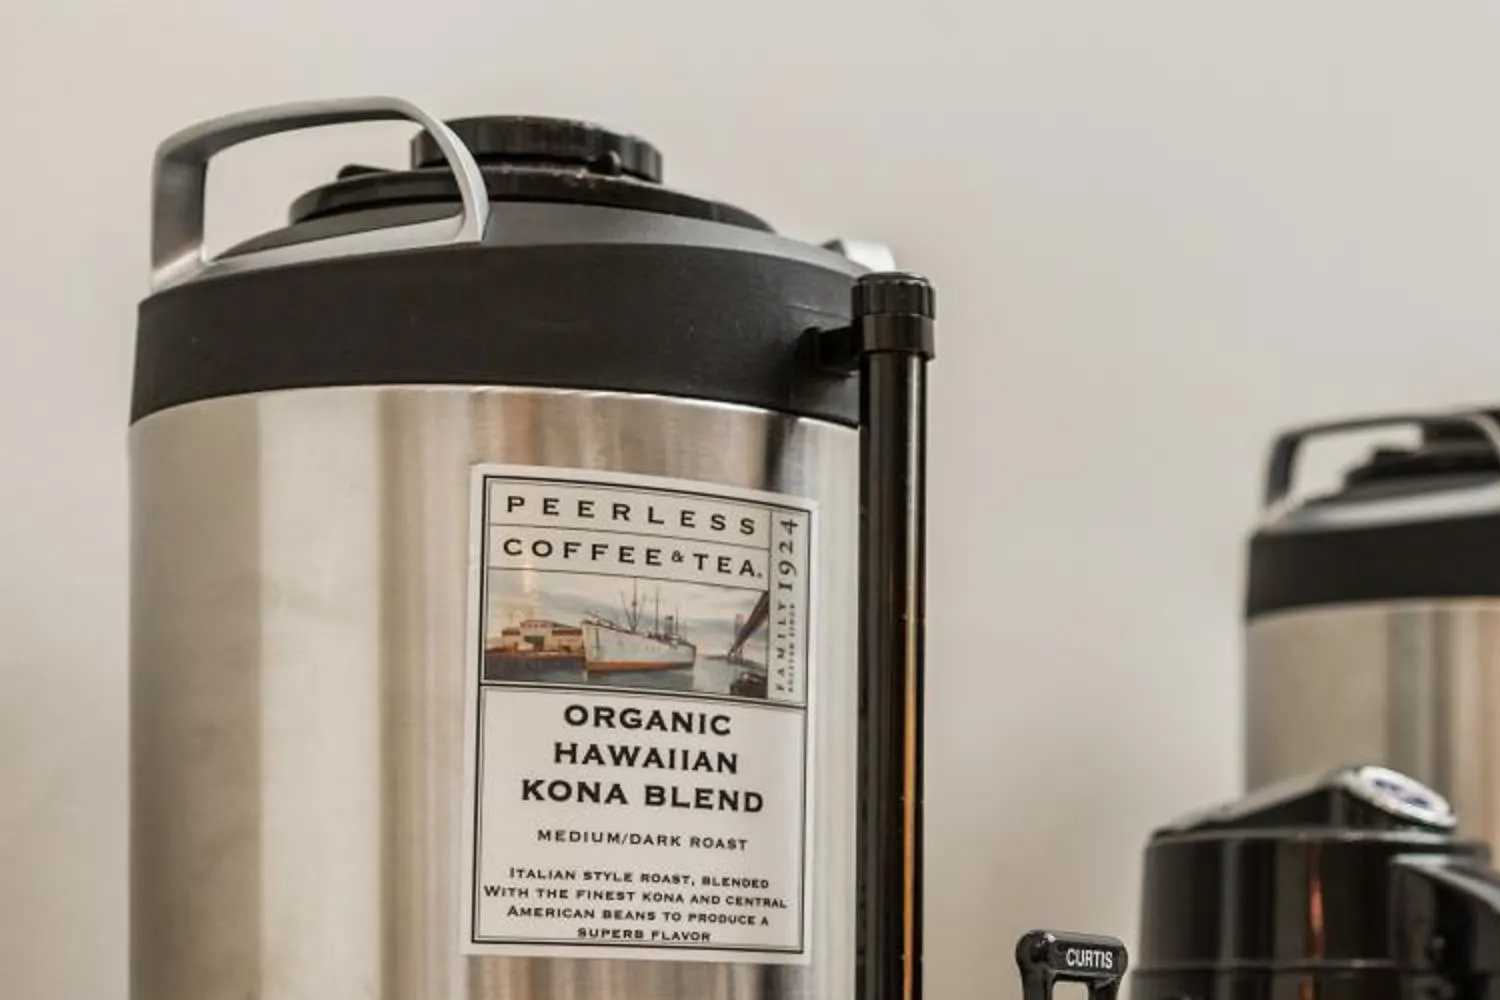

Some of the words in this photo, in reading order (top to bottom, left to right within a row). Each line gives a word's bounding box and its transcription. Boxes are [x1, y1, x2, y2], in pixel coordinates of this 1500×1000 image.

[506, 495, 756, 535] PEERLESS
[778, 518, 799, 592] 1924
[563, 704, 732, 736] ORGANIC
[553, 742, 739, 775] HAWAIIAN
[522, 779, 629, 805] KONA
[644, 785, 764, 813] BLEND
[537, 829, 682, 848] MEDIUM/DARK
[690, 837, 748, 850] ROAST
[509, 867, 576, 881] ITALIAN
[583, 871, 633, 883] STYLE
[640, 873, 695, 886] ROAST,
[701, 876, 769, 889] BLENDED
[484, 885, 529, 898] WITH
[536, 888, 569, 899] THE
[576, 889, 636, 901] FINEST
[642, 892, 684, 904] KONA
[690, 895, 721, 905] AND
[725, 896, 788, 909] CENTRAL
[507, 905, 595, 919] AMERICAN
[602, 909, 656, 921] BEANS
[662, 911, 681, 922] TO
[687, 912, 756, 926] PRODUCE
[760, 916, 769, 926] A
[577, 927, 644, 939] SUPERB
[651, 930, 711, 942] FLAVOR
[1065, 948, 1113, 969] CURTIS
